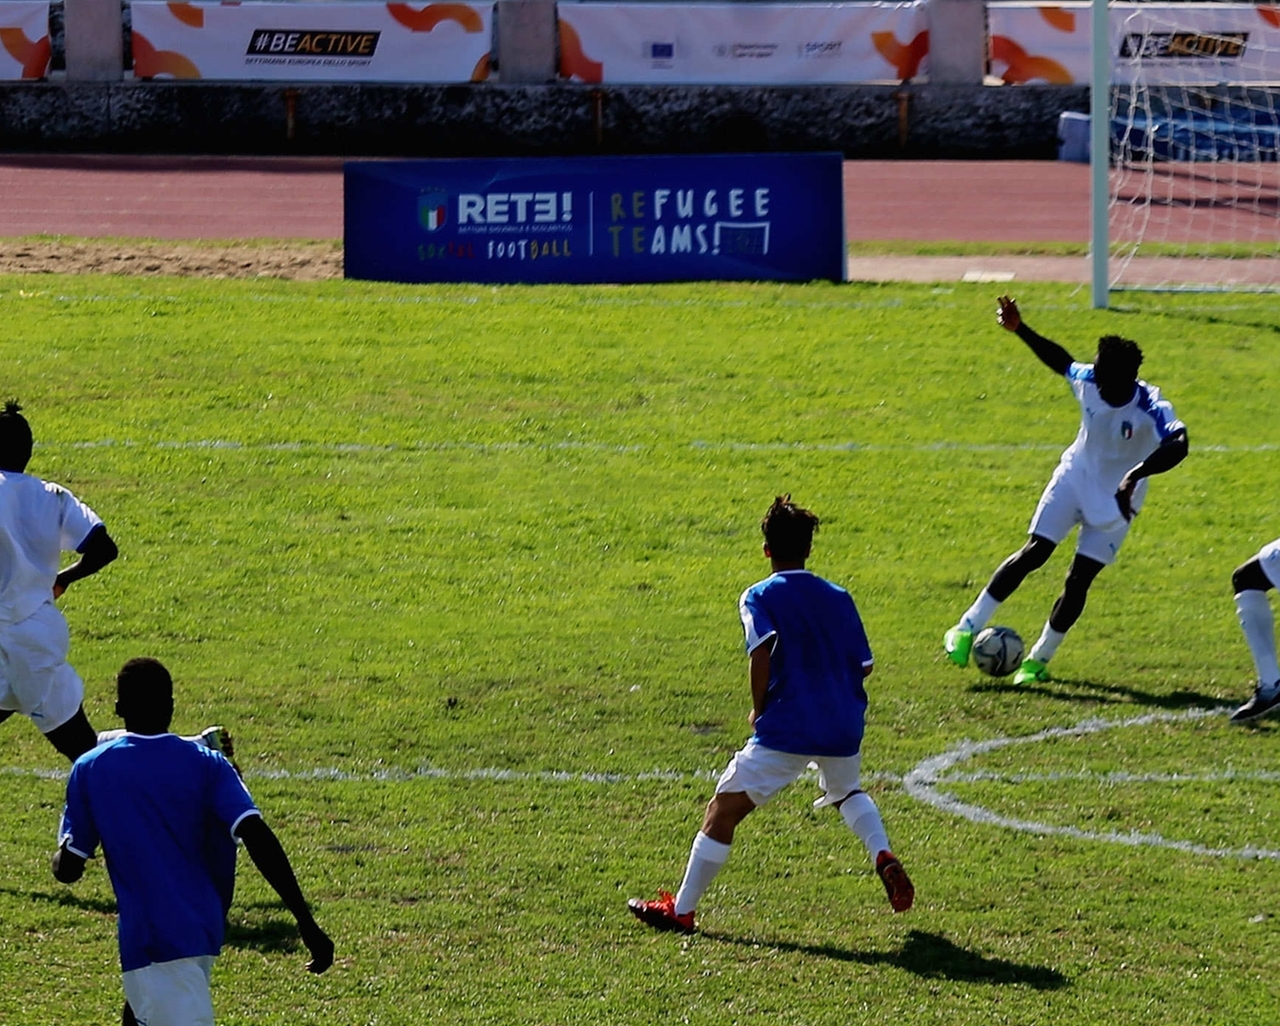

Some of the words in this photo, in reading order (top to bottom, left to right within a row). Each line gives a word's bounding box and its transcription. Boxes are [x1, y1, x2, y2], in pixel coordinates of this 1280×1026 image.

[254, 32, 375, 54] #BEACTIVE
[610, 187, 770, 222] REFUGEE
[487, 238, 573, 261] FOOTBALL
[608, 222, 721, 258] TEAMS!
